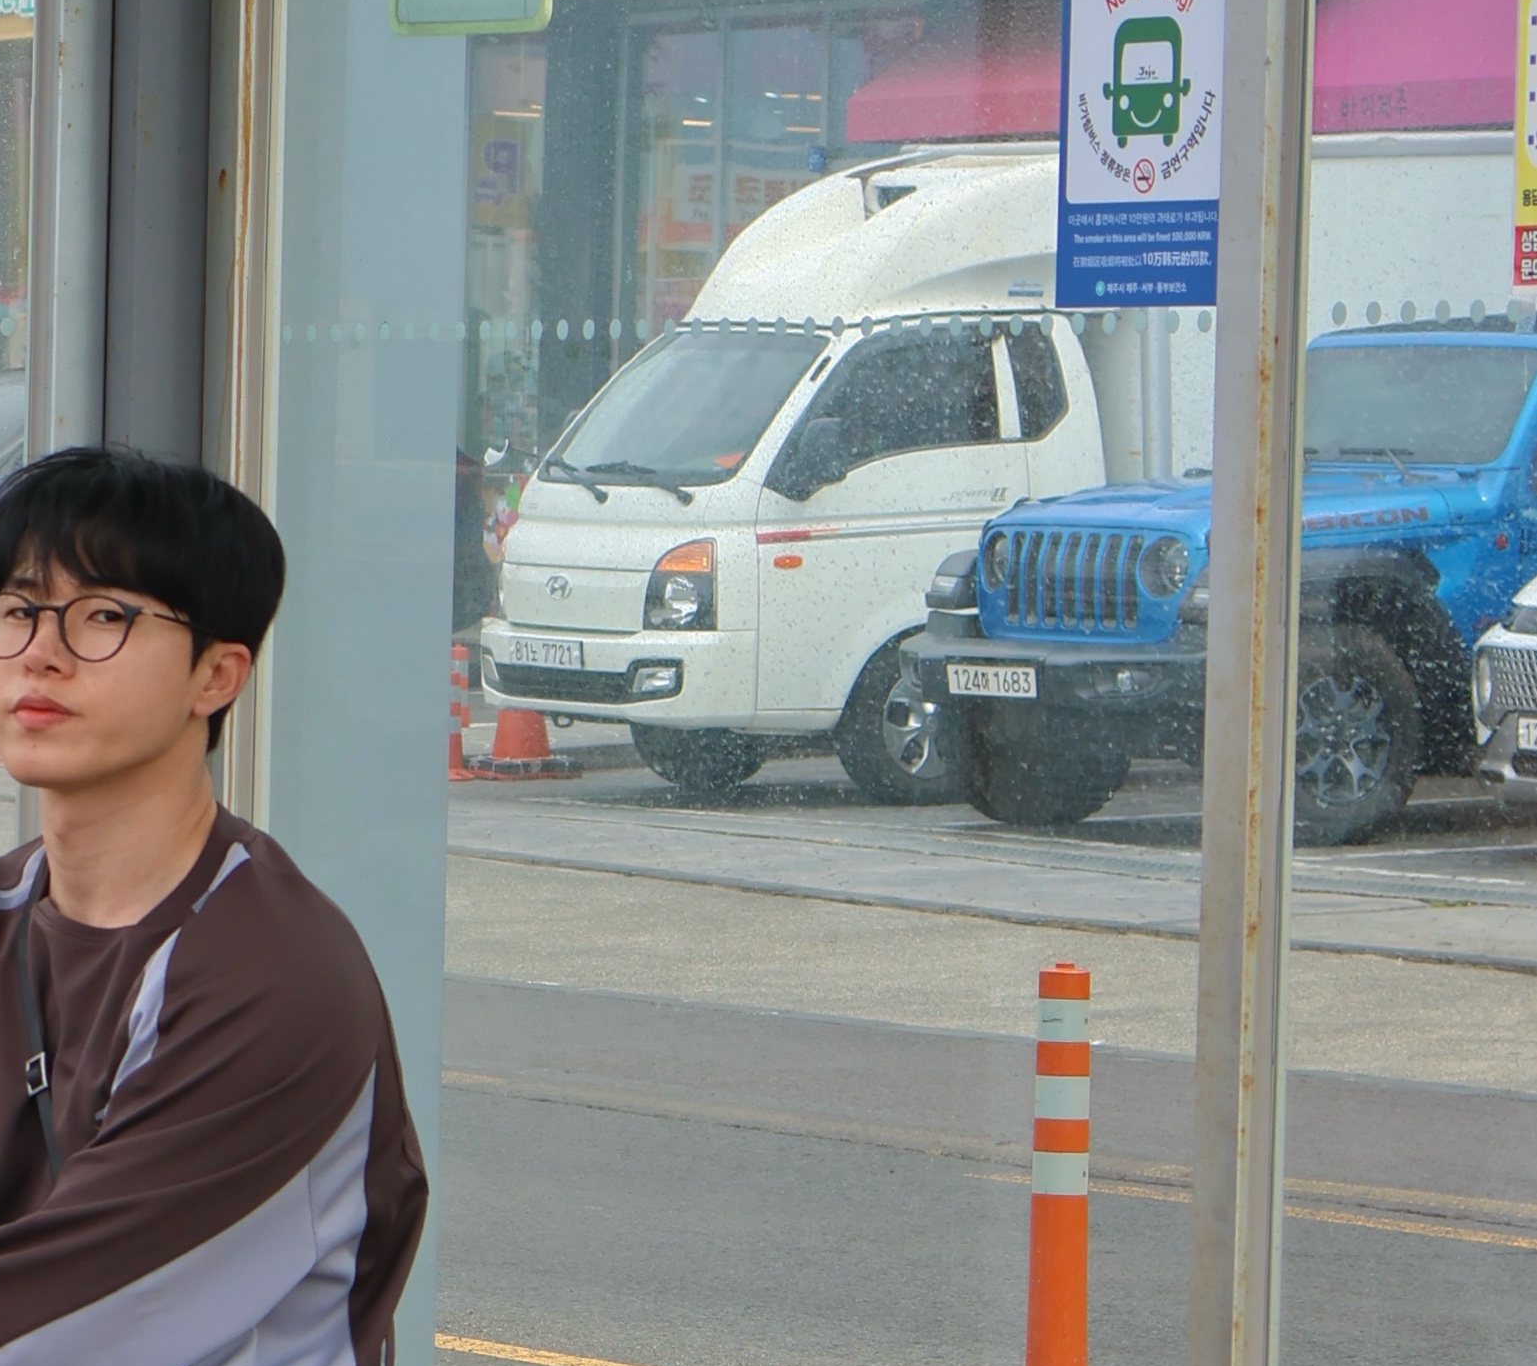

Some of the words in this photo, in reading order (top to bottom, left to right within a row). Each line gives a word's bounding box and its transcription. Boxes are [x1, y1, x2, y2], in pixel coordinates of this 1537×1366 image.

[1161, 90, 1216, 180] 금연구역입니다
[1074, 234, 1084, 244] The
[515, 640, 538, 662] 81노
[543, 643, 573, 666] 7721
[993, 670, 1032, 694] 1683
